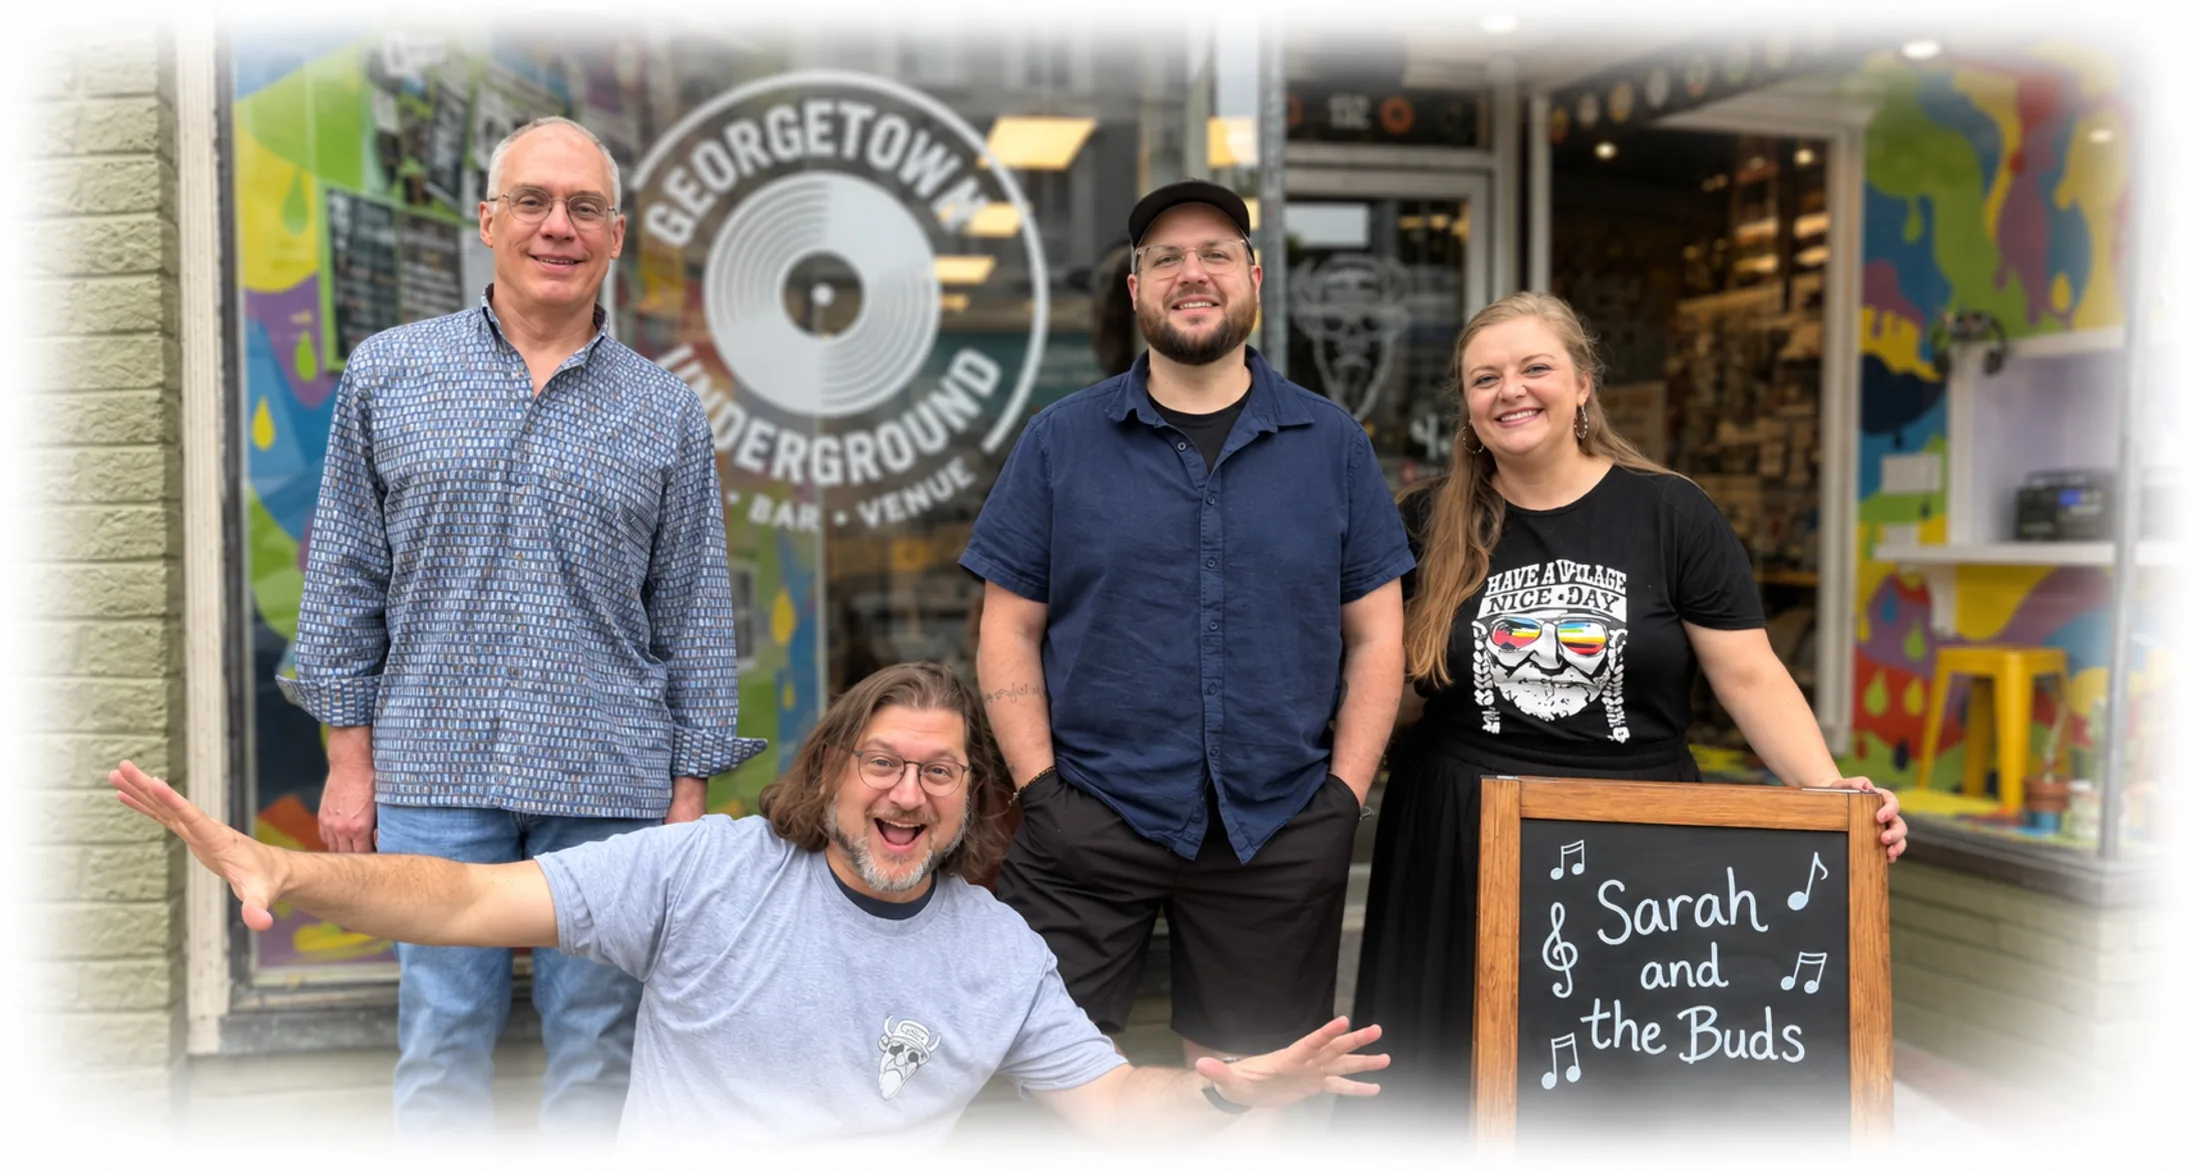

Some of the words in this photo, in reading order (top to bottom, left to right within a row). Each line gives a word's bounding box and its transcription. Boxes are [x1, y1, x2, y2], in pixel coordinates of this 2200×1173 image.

[645, 99, 989, 246] GEORGETOWN
[748, 493, 820, 533] BAR
[855, 455, 976, 529] VENUE
[1485, 563, 1539, 596] HAVE
[1541, 562, 1556, 585] A
[1486, 587, 1552, 614] NICE
[1566, 586, 1620, 613] DAY
[1597, 866, 1769, 946] Sarah
[1640, 941, 1730, 990] and
[1580, 998, 1668, 1055] the
[1676, 1004, 1806, 1065] Buds
